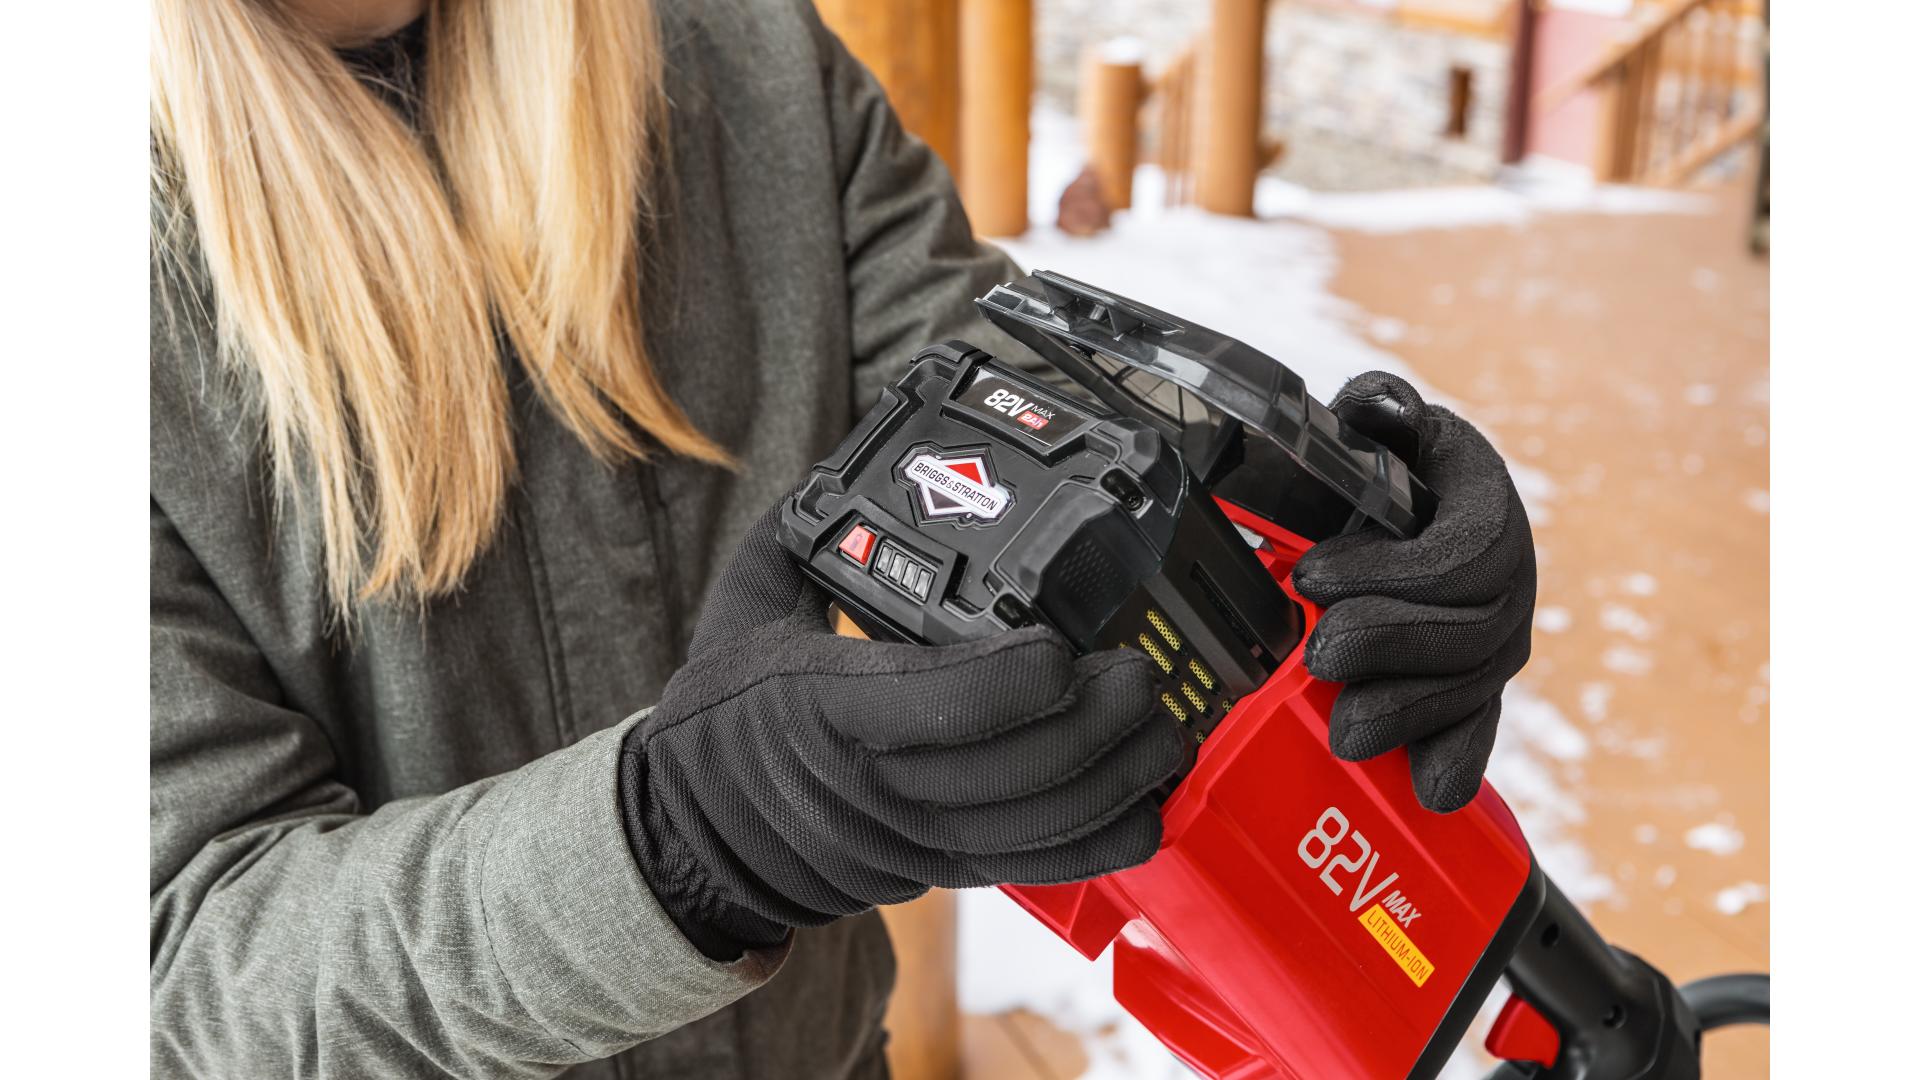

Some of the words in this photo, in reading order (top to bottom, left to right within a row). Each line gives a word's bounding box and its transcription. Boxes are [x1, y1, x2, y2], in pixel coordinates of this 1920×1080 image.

[984, 389, 1035, 417] 82V
[1031, 405, 1055, 420] MAX
[1297, 806, 1400, 912] 82V
[1381, 889, 1421, 928] MAX
[1366, 909, 1429, 980] LITHIUM-ION
